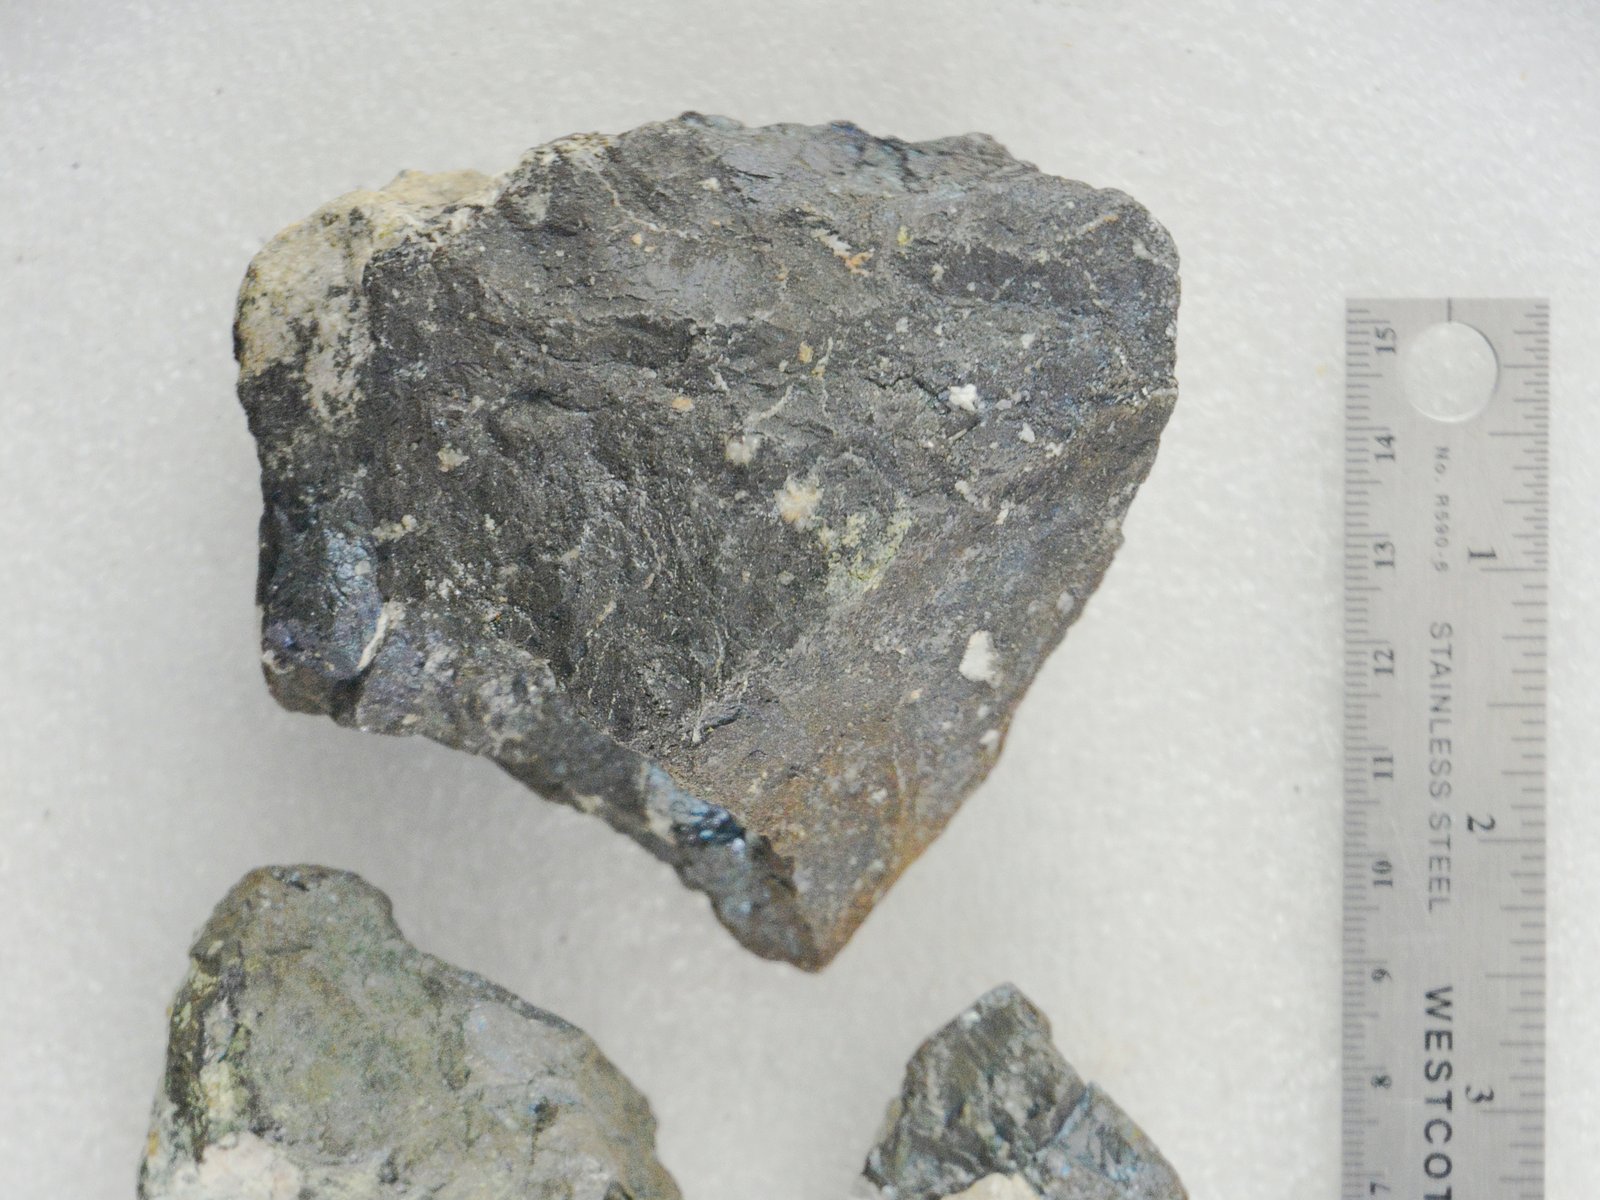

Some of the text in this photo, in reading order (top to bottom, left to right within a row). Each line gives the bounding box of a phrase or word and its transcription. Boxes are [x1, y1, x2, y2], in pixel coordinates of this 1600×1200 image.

[1374, 327, 1396, 354] 15
[1374, 434, 1395, 461] 14
[1374, 540, 1395, 569] 13
[1468, 547, 1496, 561] 1
[1373, 649, 1394, 677] 12
[1372, 755, 1393, 781] 11
[1428, 621, 1453, 914] STAINLESS STEEL
[1467, 814, 1496, 833] 2
[1372, 860, 1393, 888] 10
[1371, 967, 1392, 983] 9
[1371, 1074, 1392, 1090] 8
[1465, 1084, 1494, 1104] 3
[1370, 1181, 1391, 1196] 7
